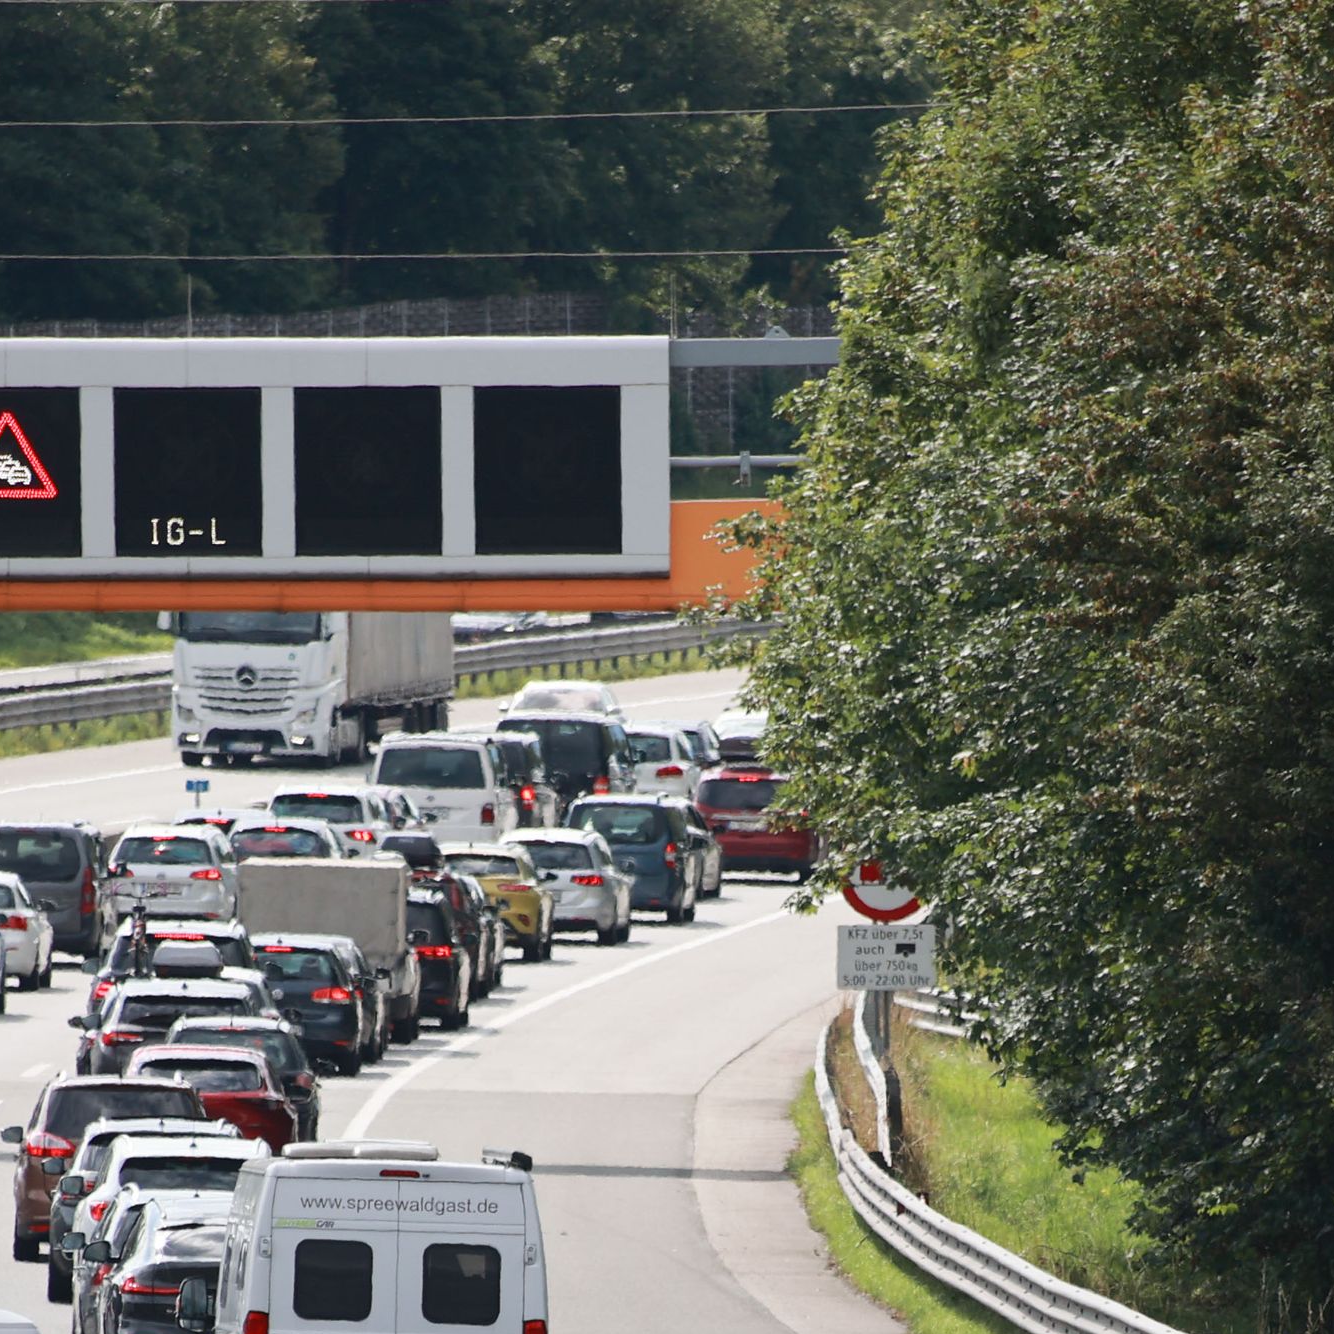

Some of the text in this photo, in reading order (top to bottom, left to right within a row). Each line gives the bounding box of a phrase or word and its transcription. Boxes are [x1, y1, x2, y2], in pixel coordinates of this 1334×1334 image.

[151, 517, 226, 545] IG-L
[848, 929, 867, 940] KFZ
[872, 929, 898, 940] über
[855, 945, 884, 955] auch
[855, 960, 882, 971] über
[909, 975, 930, 986] Uhr
[300, 1196, 499, 1215] www.spreewaldgast.de
